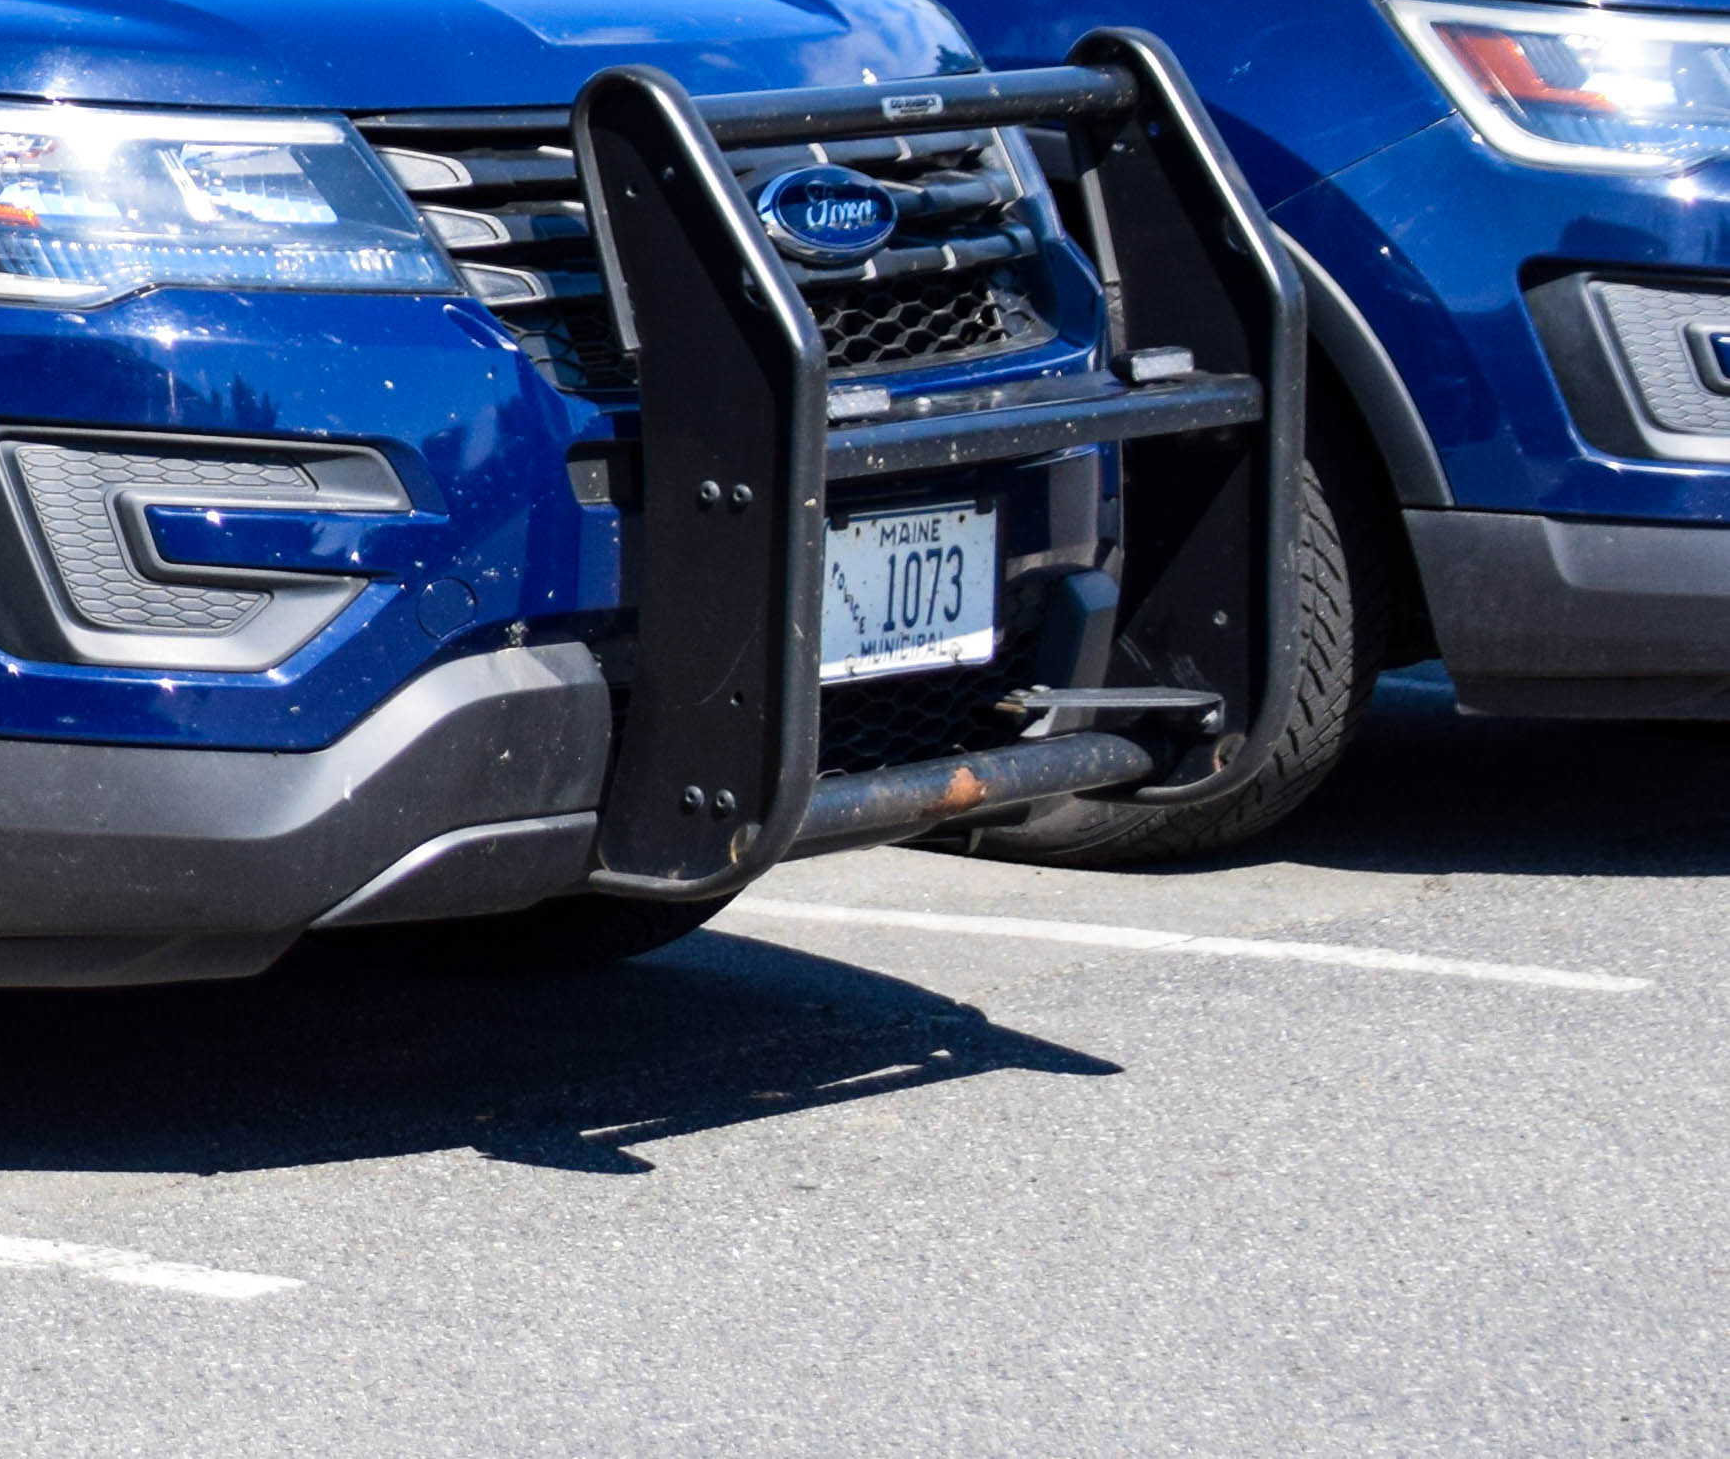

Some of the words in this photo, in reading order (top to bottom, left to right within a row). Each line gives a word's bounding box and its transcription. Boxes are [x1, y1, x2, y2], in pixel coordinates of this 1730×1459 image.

[878, 518, 942, 548] MAINE
[882, 544, 964, 632] 1073
[860, 631, 947, 662] MUNICIPAL
